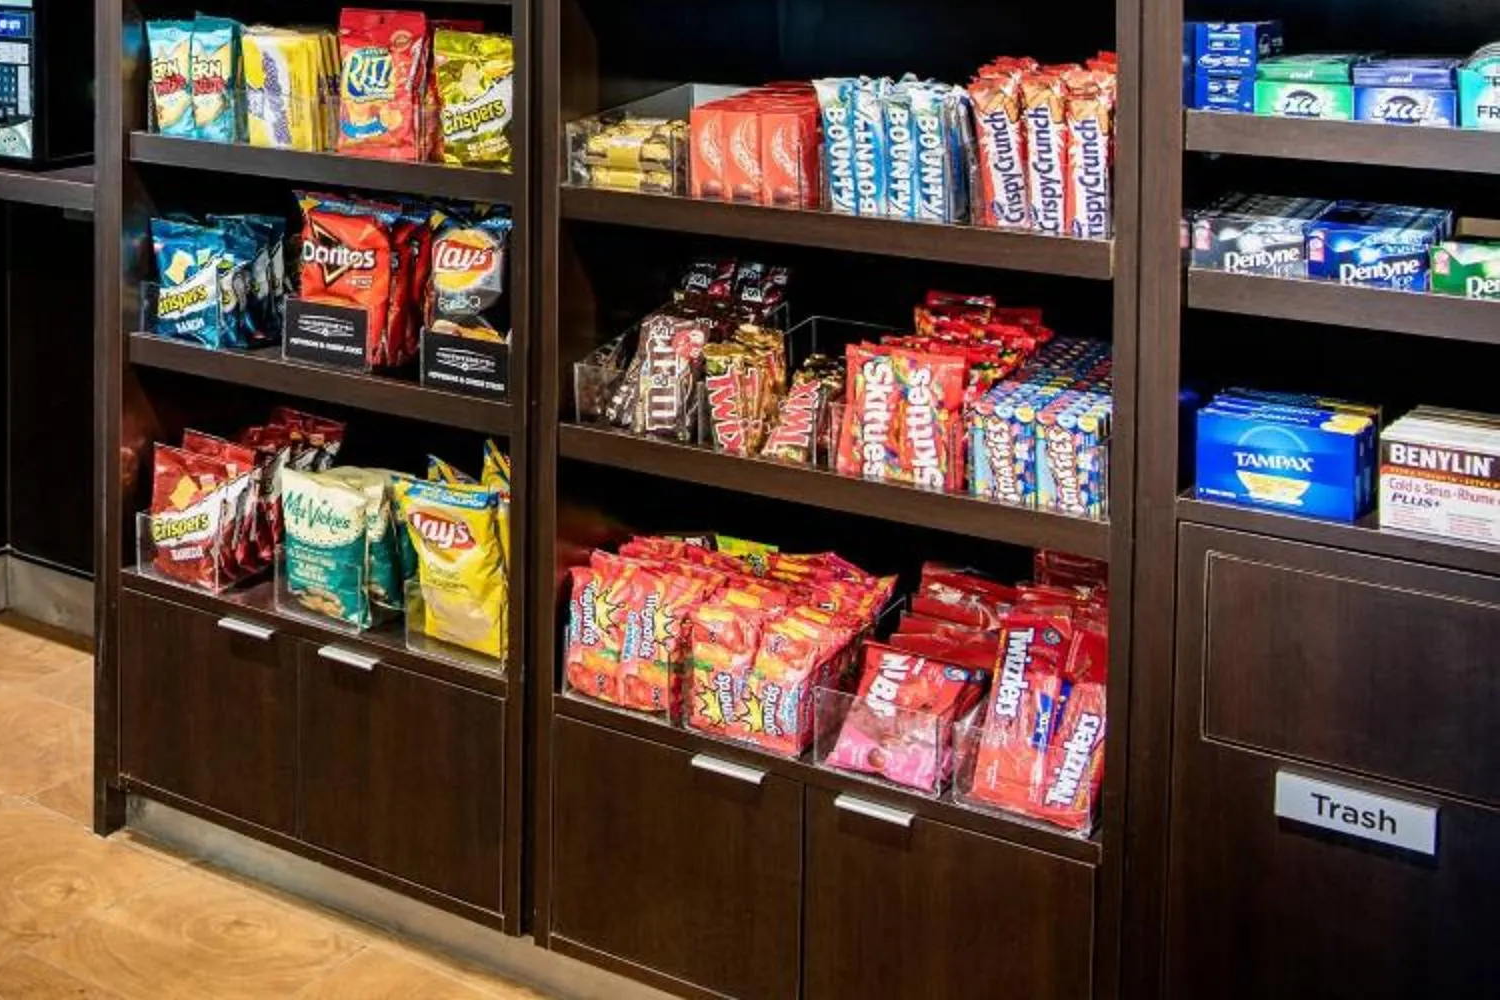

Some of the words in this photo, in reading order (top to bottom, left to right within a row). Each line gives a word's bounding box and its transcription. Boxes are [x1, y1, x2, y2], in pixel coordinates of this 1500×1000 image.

[441, 99, 506, 136] Crispers
[825, 107, 856, 209] BOUNTY
[854, 110, 877, 213] BOUNTY
[888, 108, 911, 212] BOUNTY
[917, 116, 944, 216] BOUNTY
[1074, 117, 1106, 237] rispyCrunch
[301, 240, 376, 269] Doritos
[435, 241, 487, 272] Lay's
[1224, 246, 1300, 271] Dentyne
[1339, 259, 1420, 284] Dentyne
[863, 361, 893, 481] Skittles
[906, 366, 944, 488] Skittles
[1233, 451, 1313, 473] TAMPAX
[1389, 443, 1491, 478] BENYLIN
[411, 510, 470, 549] Lay's
[996, 627, 1035, 719] Twizzlers
[1045, 711, 1102, 806] Twizzlers
[1310, 792, 1397, 835] Trash
